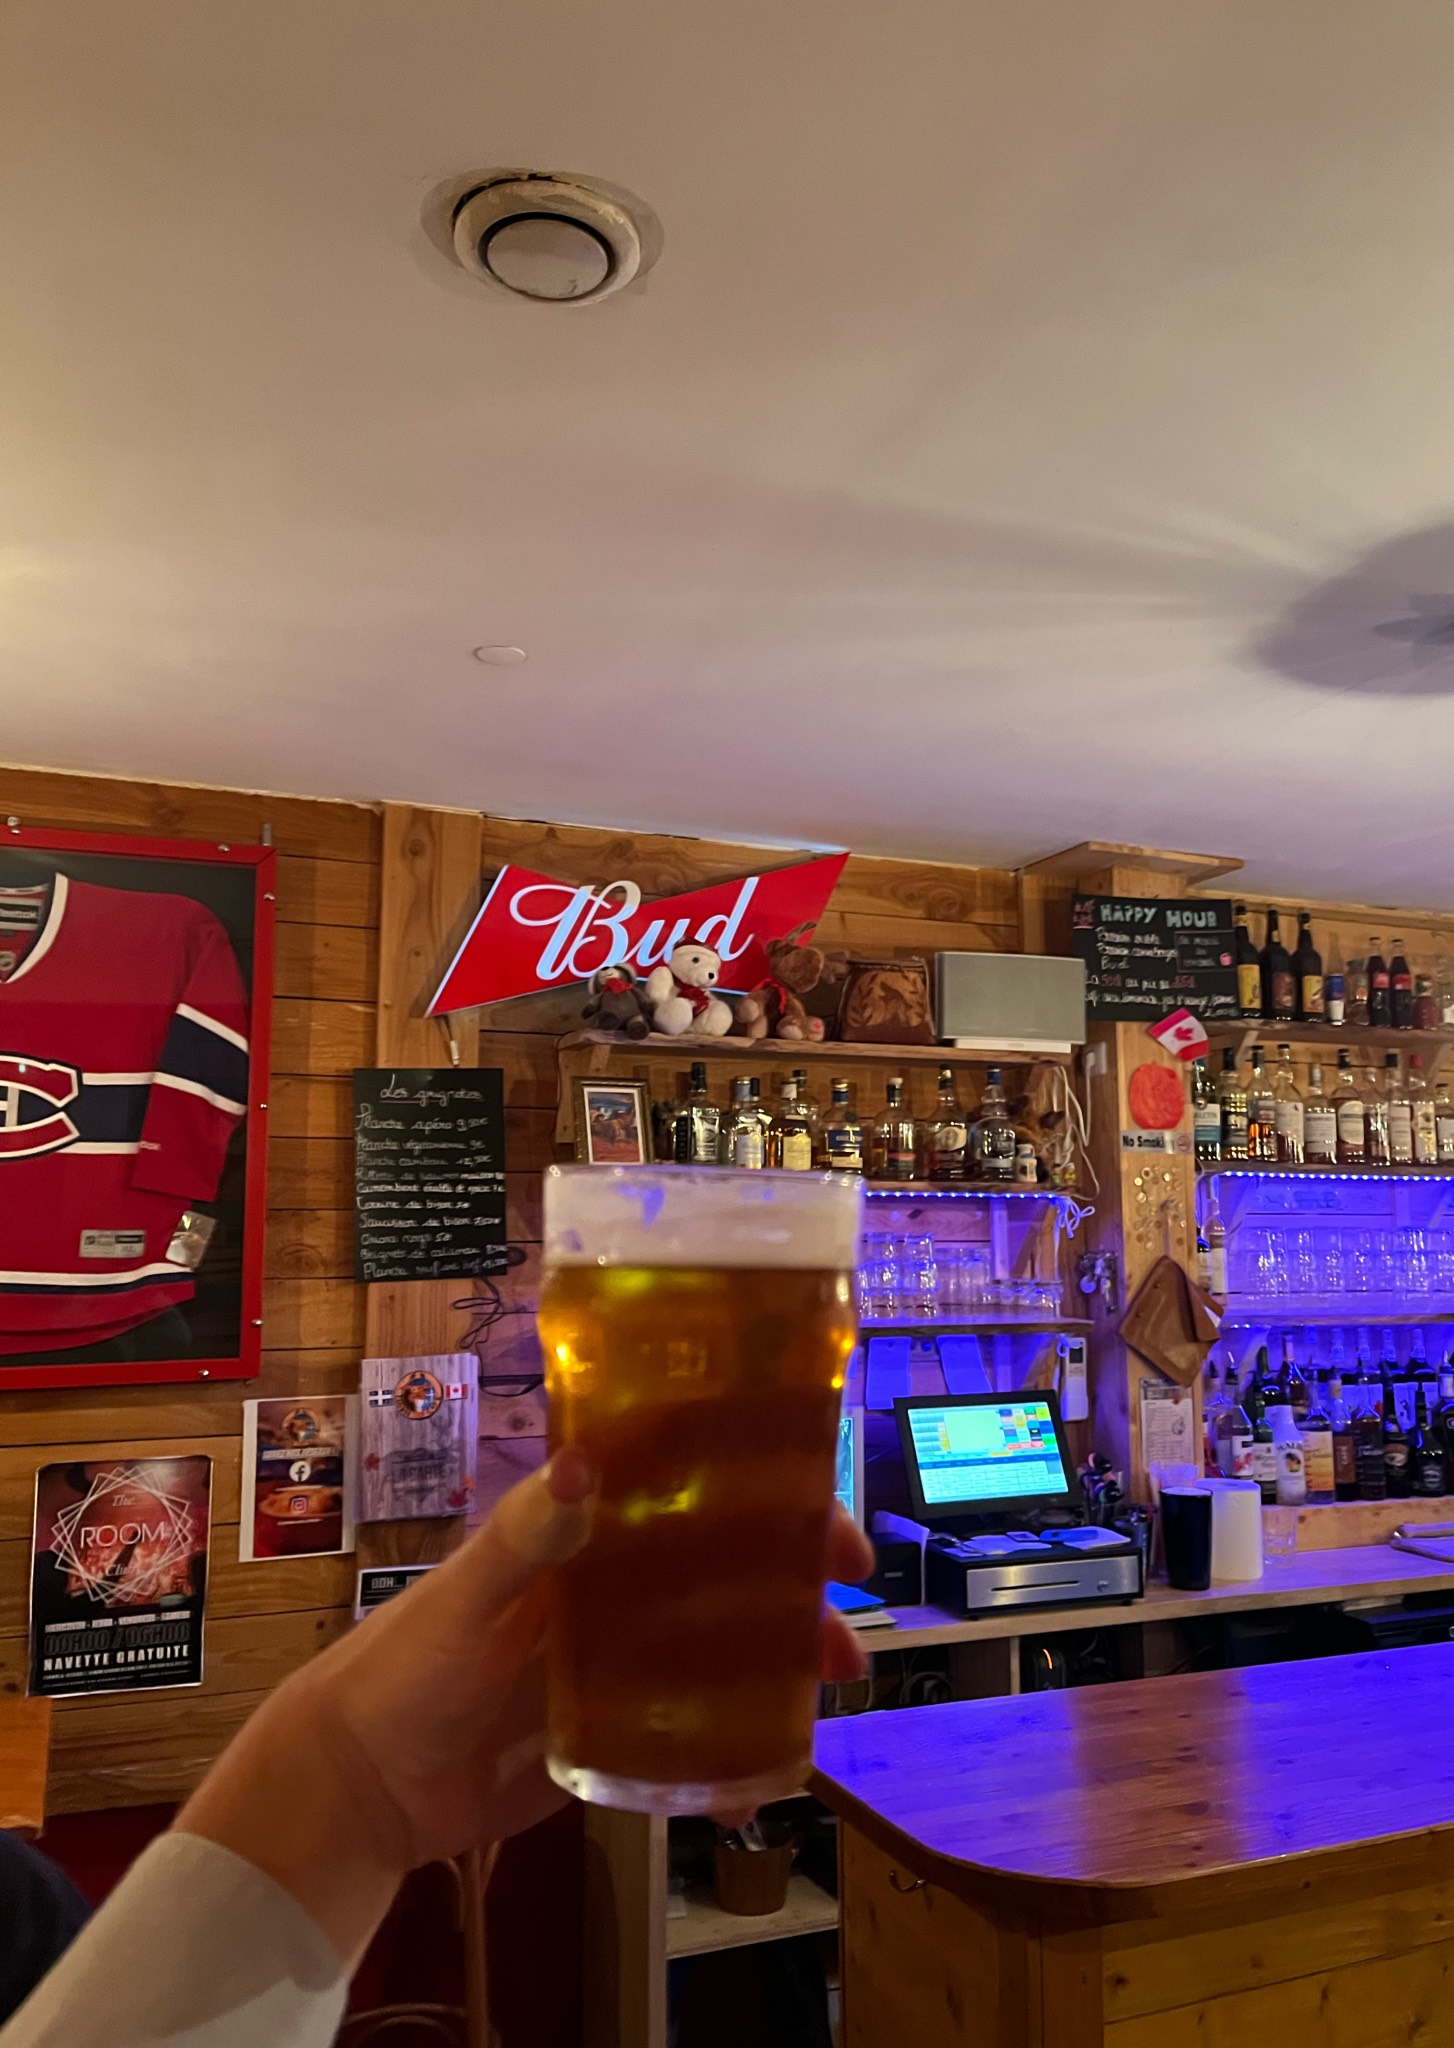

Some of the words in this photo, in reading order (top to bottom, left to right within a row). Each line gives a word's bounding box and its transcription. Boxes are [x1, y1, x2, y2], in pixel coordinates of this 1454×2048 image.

[509, 879, 759, 981] Bud
[1165, 909, 1217, 928] HOUR
[380, 1074, 408, 1099] Les
[1122, 1135, 1134, 1147] No
[80, 1521, 167, 1549] ROOM
[43, 1652, 110, 1671] NAVETTE
[115, 1644, 189, 1664] GRATUITE
